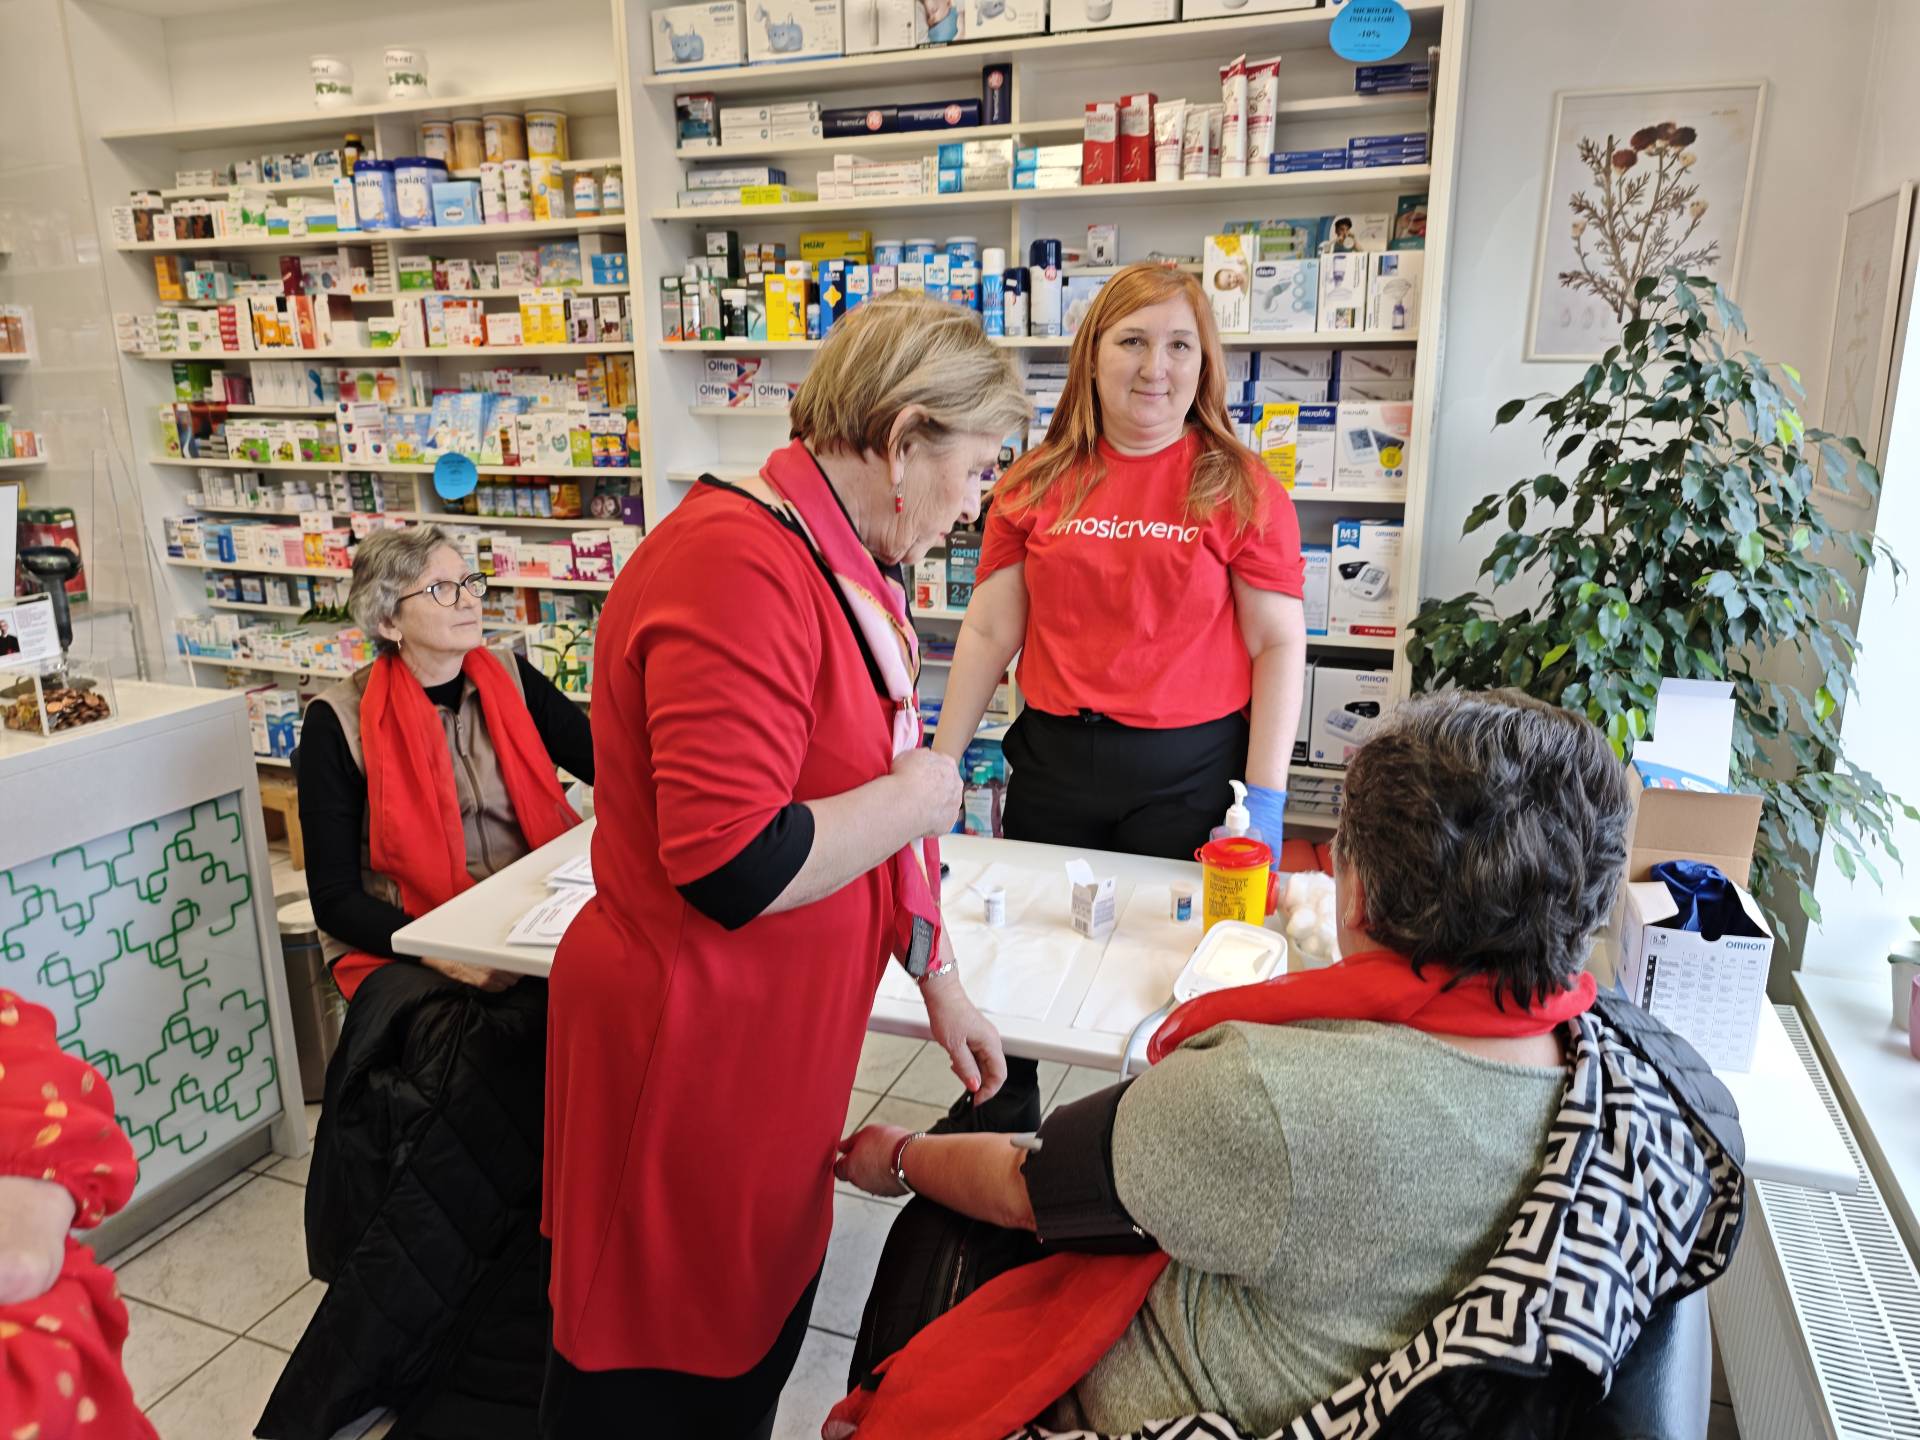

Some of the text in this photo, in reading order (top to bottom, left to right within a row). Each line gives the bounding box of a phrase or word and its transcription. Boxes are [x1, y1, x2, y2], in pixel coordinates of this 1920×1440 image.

[1358, 30, 1380, 38] -10%
[356, 178, 383, 188] valac
[708, 360, 735, 371] Olfen
[699, 385, 726, 396] Olfen
[758, 385, 786, 396] Olfen
[1299, 409, 1331, 418] microlife
[1340, 528, 1359, 540] M3
[1726, 940, 1766, 951] OMRON
